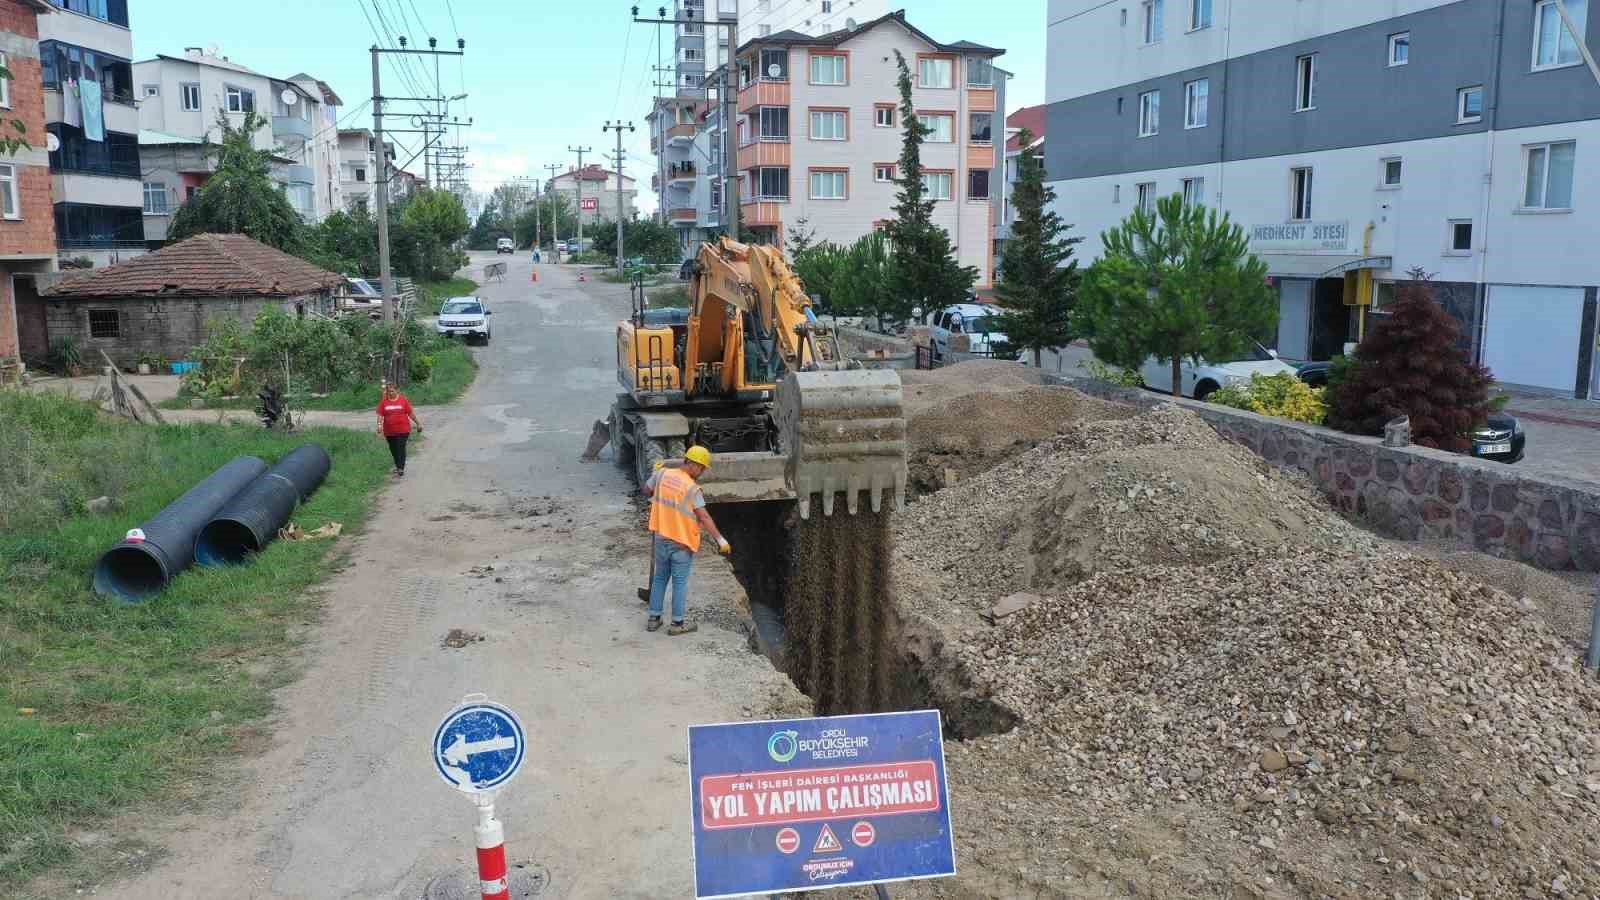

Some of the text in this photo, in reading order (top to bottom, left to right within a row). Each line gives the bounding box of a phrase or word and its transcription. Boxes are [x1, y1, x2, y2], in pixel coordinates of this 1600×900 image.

[822, 729, 846, 738] ORDU
[731, 769, 909, 791] FEN İŞLERİ DAİRESİ BAŞKANLIĞI
[708, 780, 932, 819] YOL YAPIM ÇALIŞMASI
